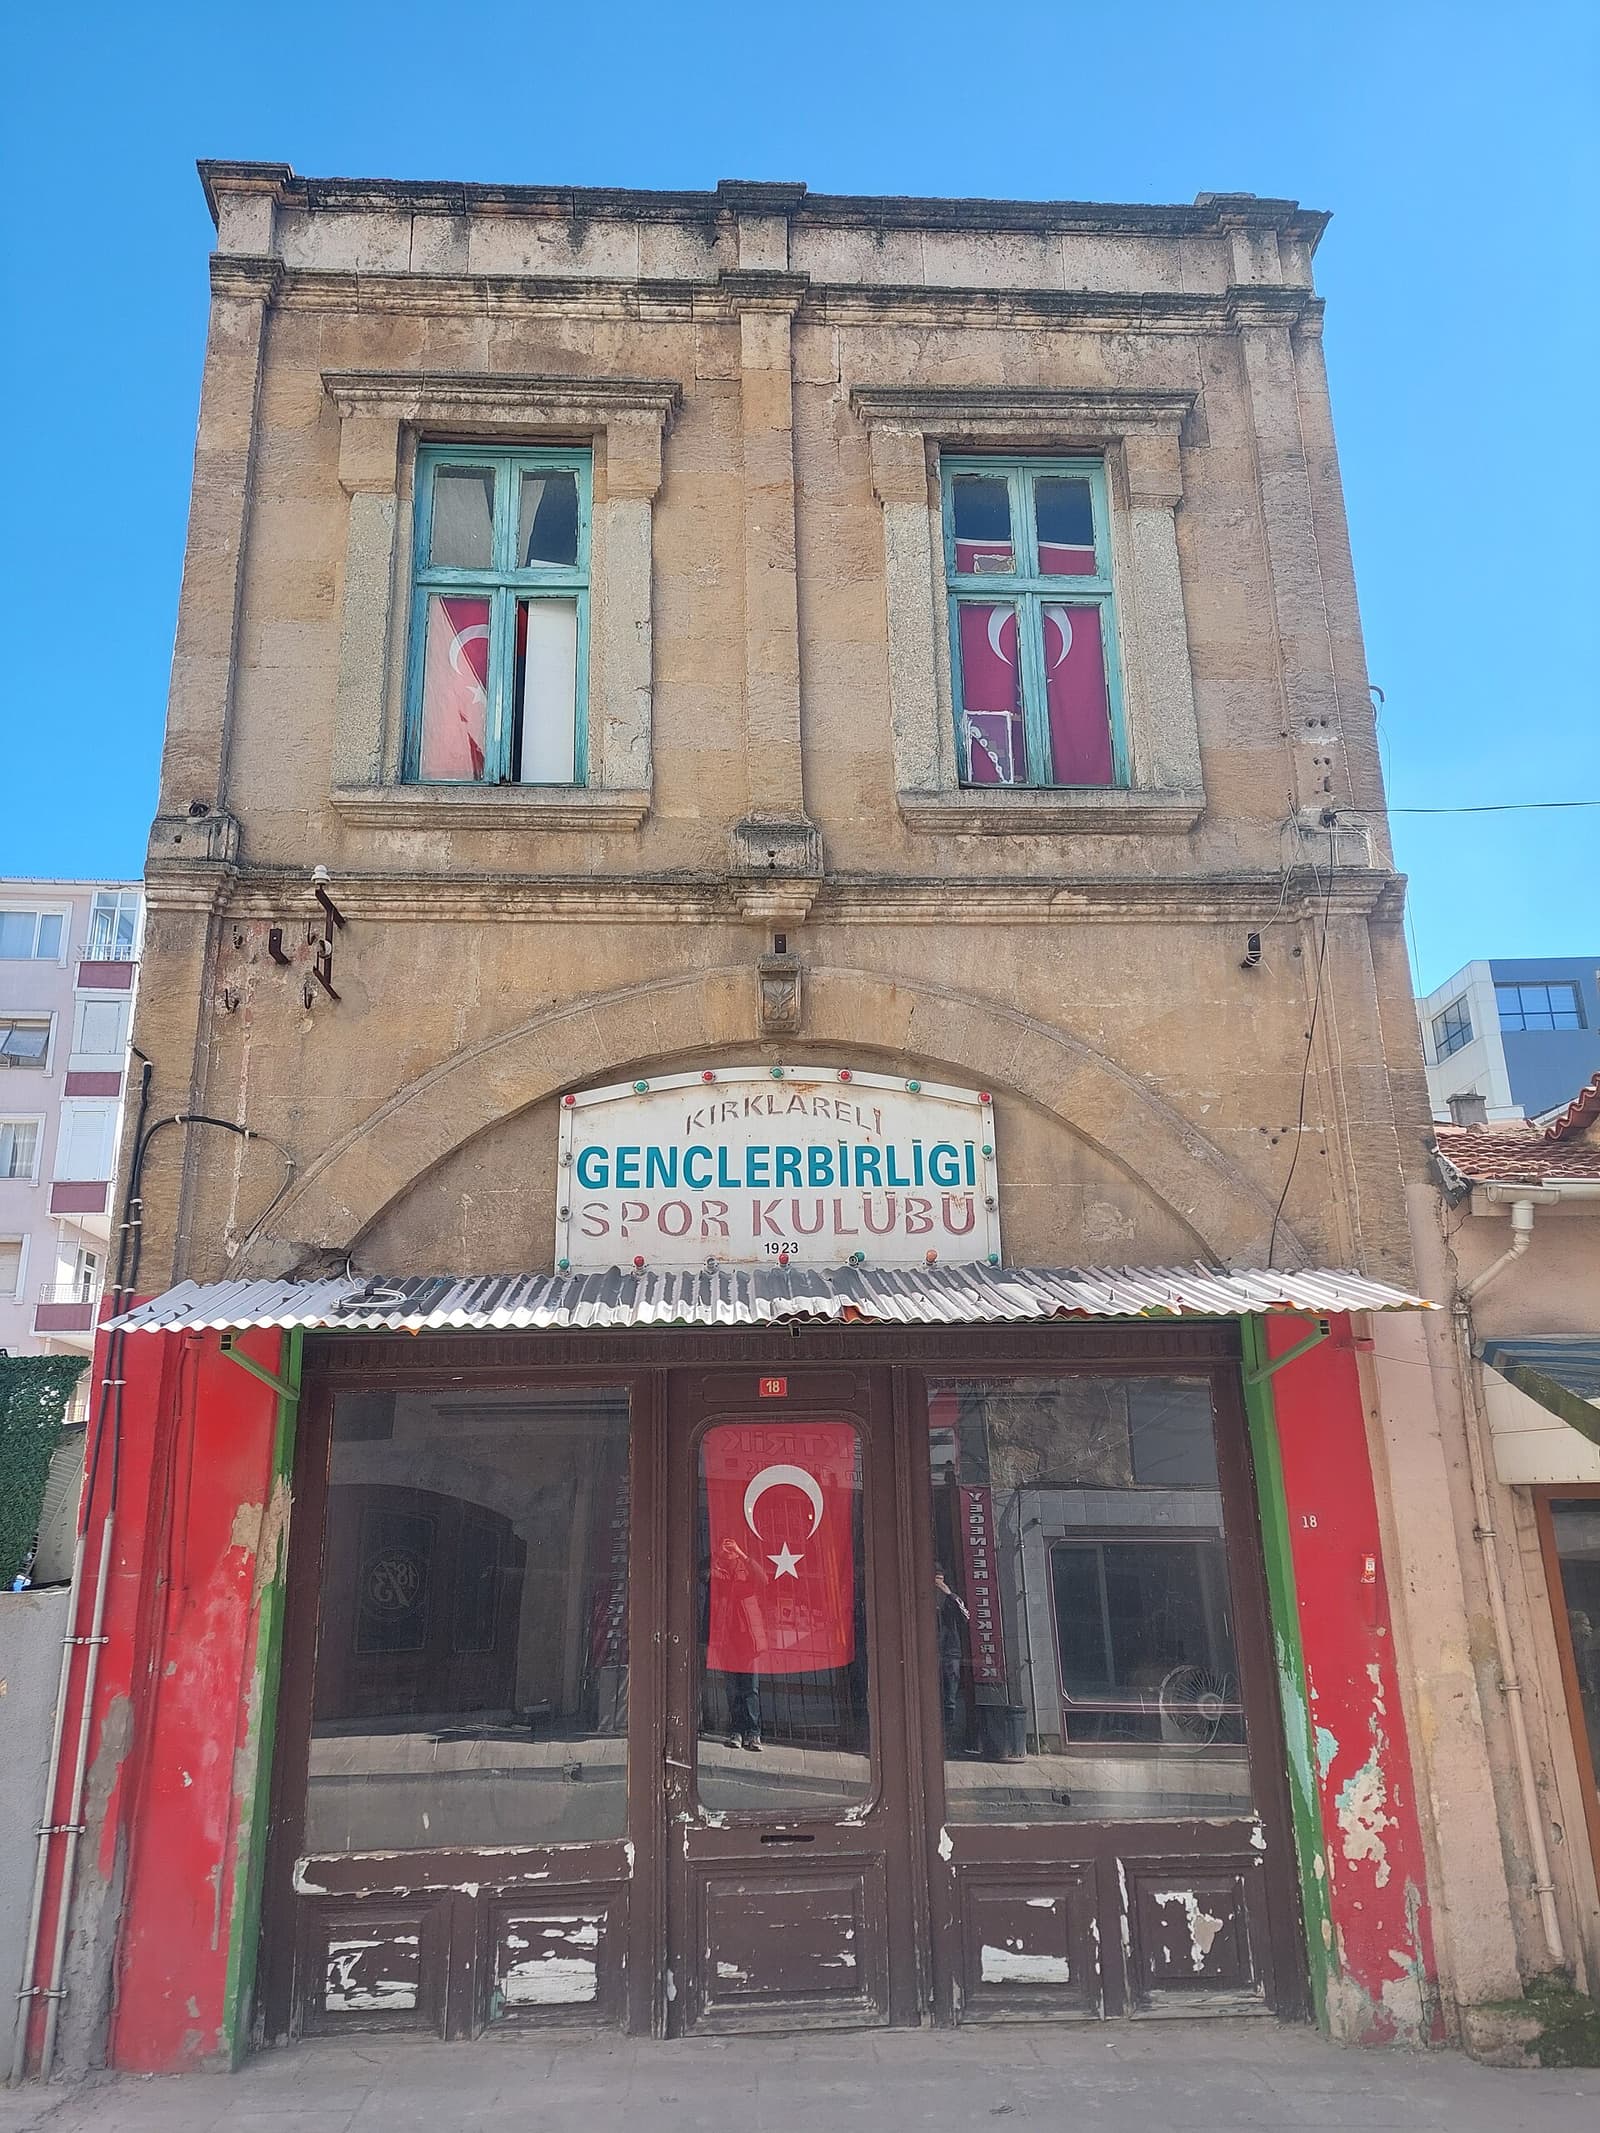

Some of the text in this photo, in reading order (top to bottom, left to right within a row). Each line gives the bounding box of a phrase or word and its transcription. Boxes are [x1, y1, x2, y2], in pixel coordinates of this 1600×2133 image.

[581, 1191, 977, 1238] SPOR KULÜBÜ
[764, 1242, 799, 1255] 1923
[766, 1380, 780, 1393] 18
[1302, 1515, 1318, 1528] 18
